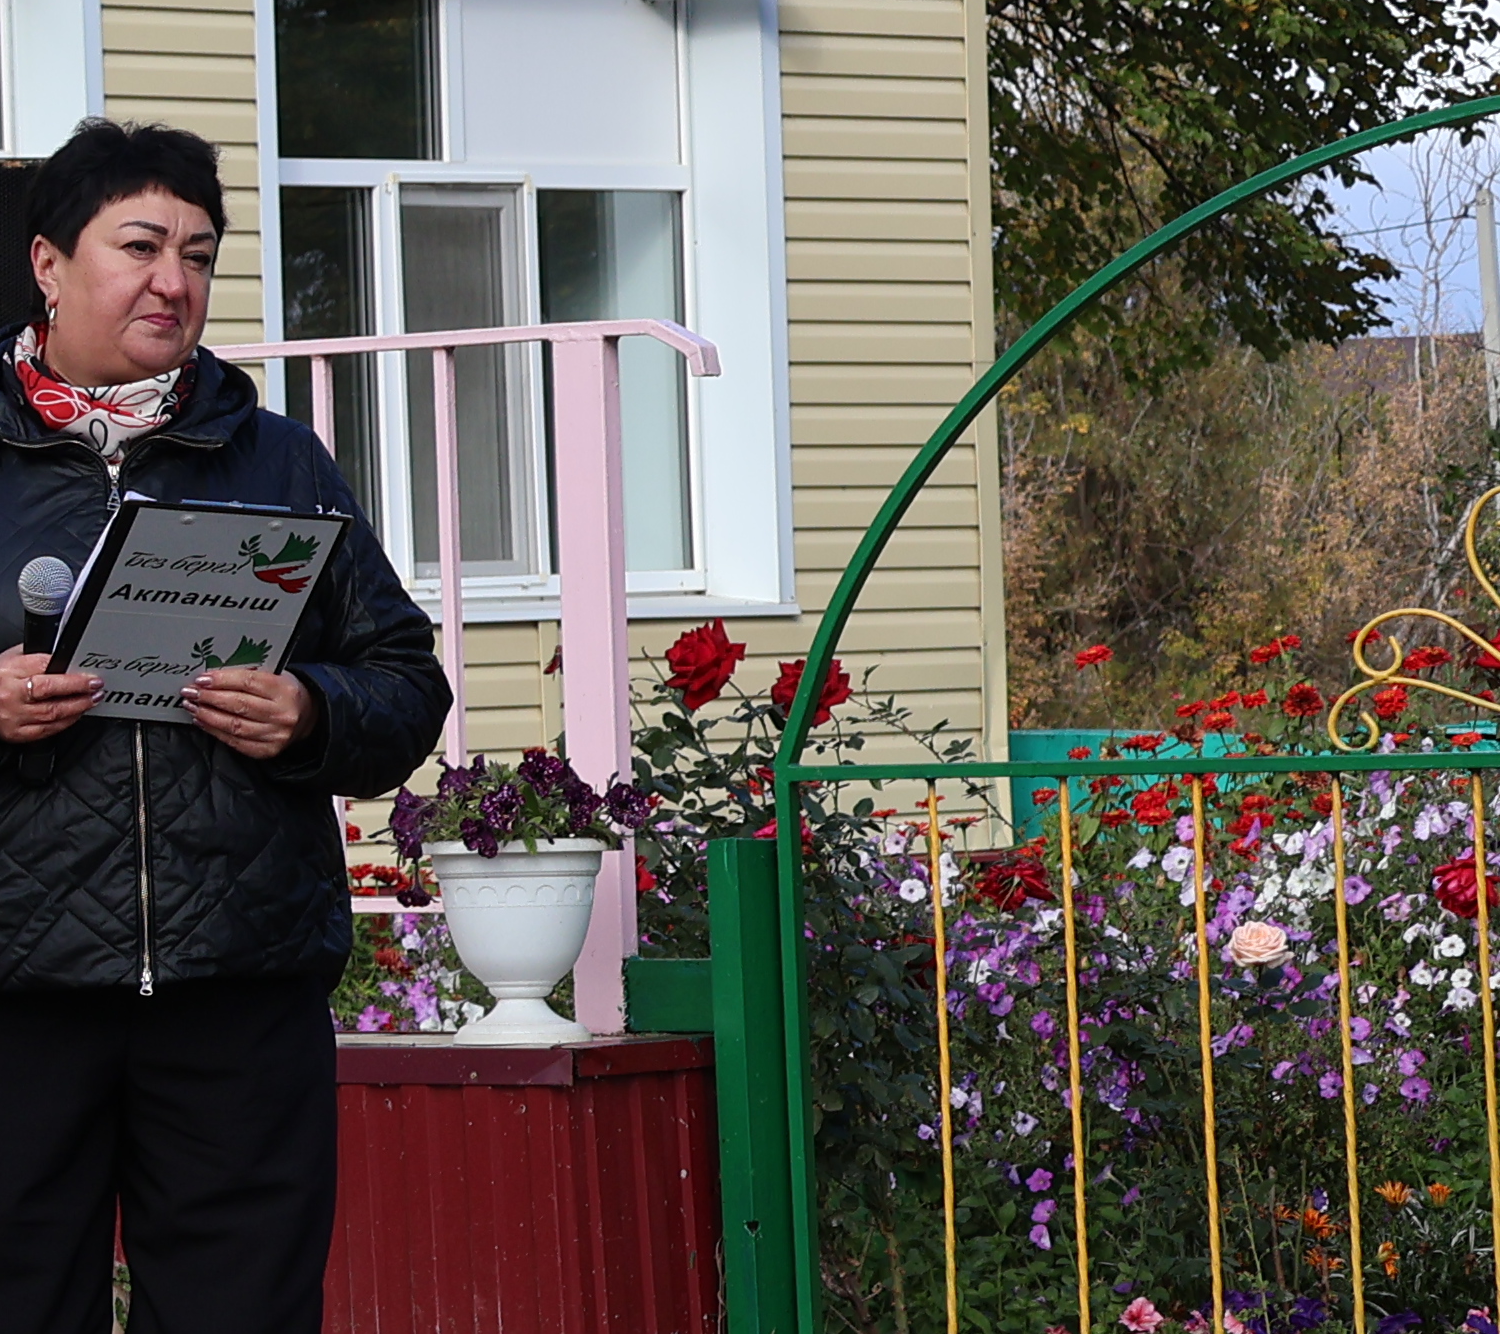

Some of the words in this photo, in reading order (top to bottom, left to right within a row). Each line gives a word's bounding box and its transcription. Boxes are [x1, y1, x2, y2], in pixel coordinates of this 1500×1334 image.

[125, 551, 168, 569] Без
[108, 583, 279, 612] Актаныш
[79, 652, 121, 670] Без
